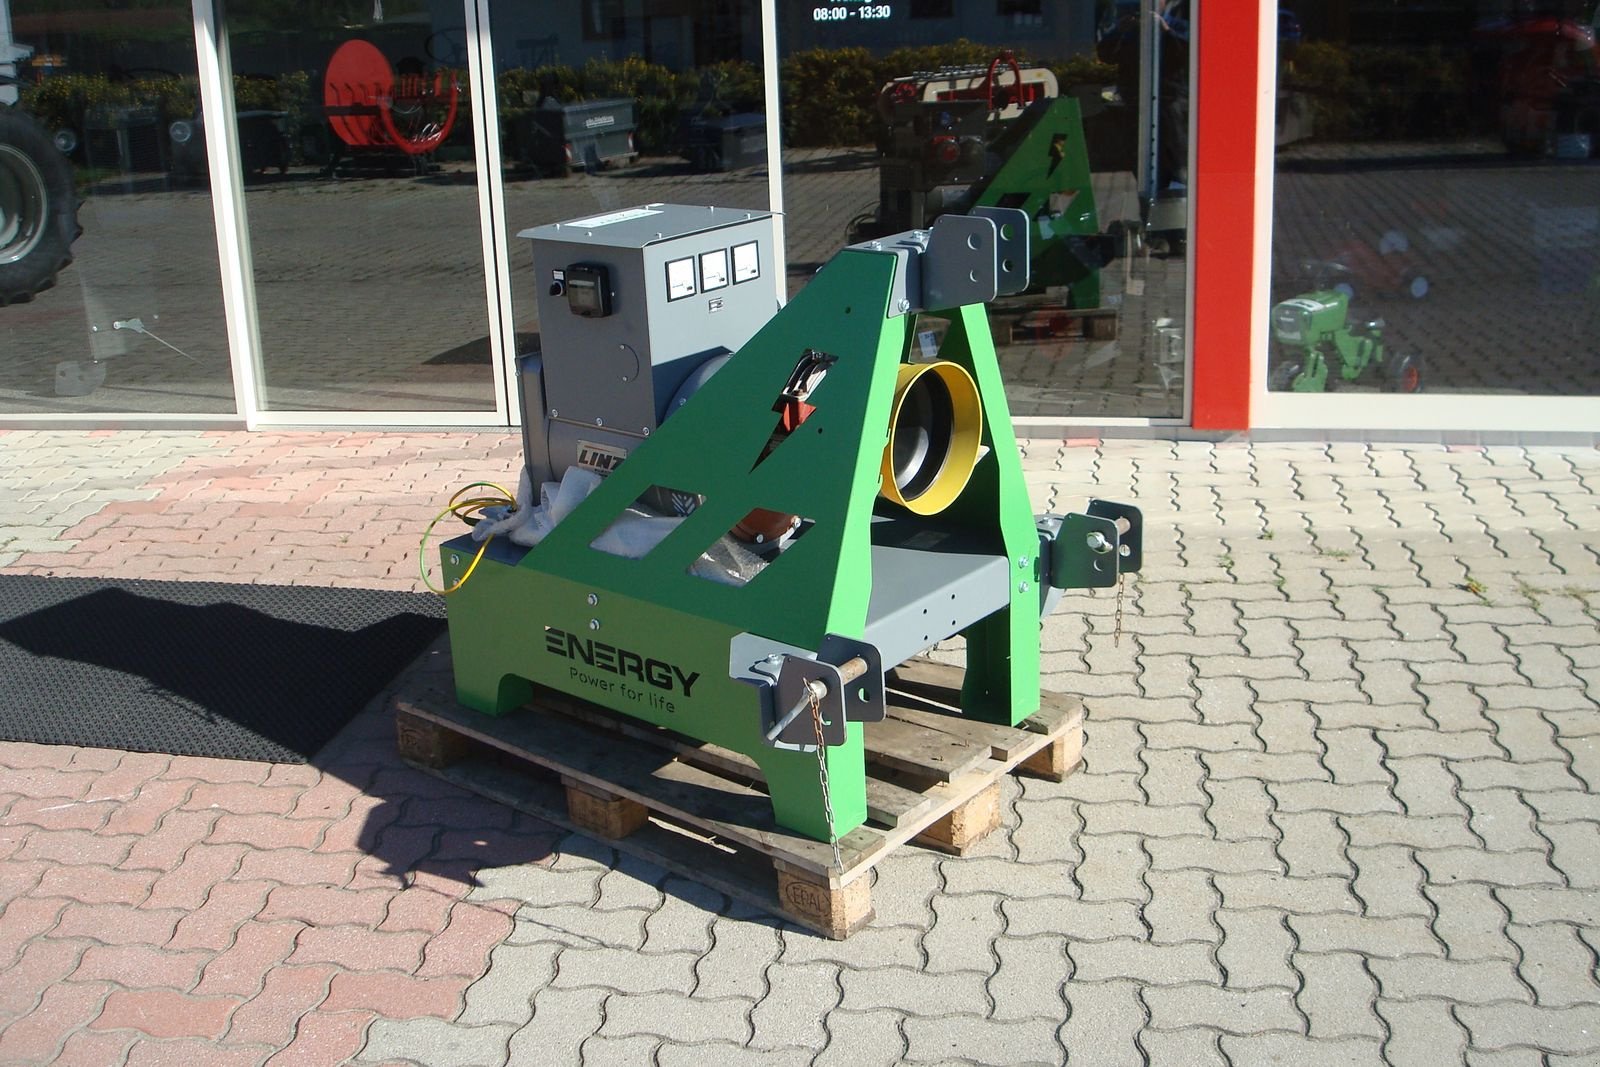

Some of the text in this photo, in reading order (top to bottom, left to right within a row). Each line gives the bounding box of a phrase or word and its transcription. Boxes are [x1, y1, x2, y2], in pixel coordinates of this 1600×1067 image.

[813, 7, 847, 20] 08:00
[858, 5, 891, 19] 13:30
[579, 449, 625, 471] LINZ
[544, 626, 700, 697] ENERGY
[569, 666, 675, 713] Power for life
